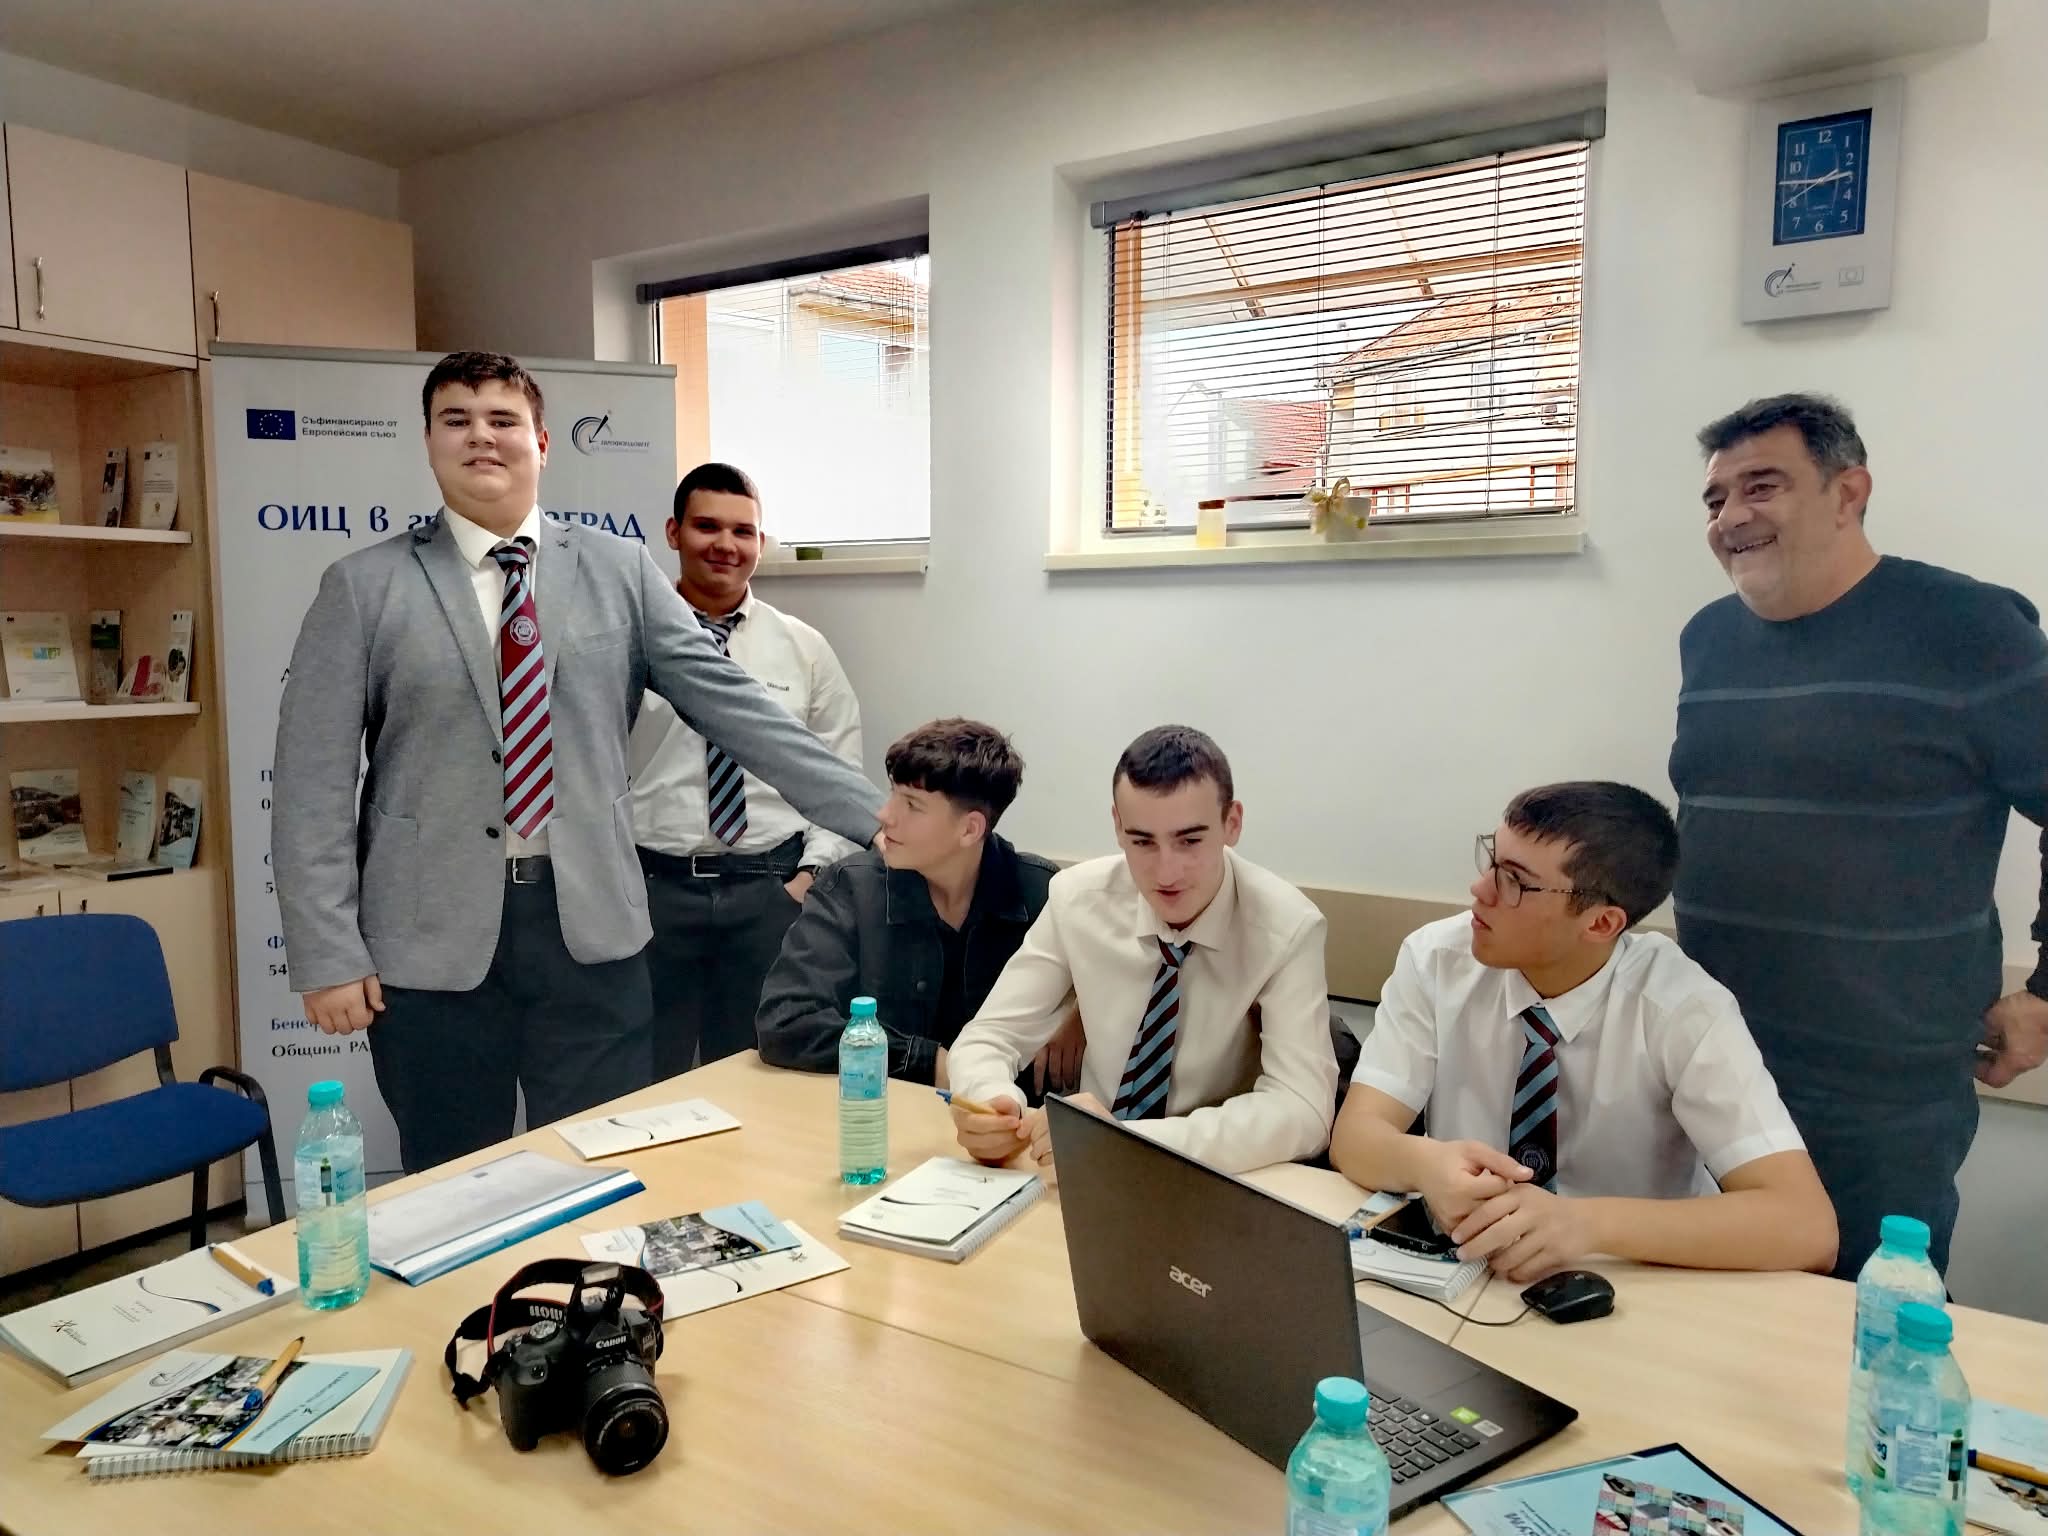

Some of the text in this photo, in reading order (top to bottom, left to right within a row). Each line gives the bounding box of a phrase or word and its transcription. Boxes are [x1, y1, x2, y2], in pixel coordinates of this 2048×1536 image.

[1818, 129, 1832, 144] 12
[1794, 143, 1806, 156] 11
[1845, 152, 1854, 166] 2
[1789, 160, 1802, 174] 10
[1842, 188, 1852, 201] 4
[1791, 216, 1801, 230] 7
[1840, 209, 1849, 224] 5
[1813, 219, 1825, 233] 6
[301, 416, 398, 428] Съфинансирано от
[302, 427, 397, 439] Европейския съюз
[257, 503, 351, 539] ОИЦ
[271, 1040, 370, 1059] Община РА
[1169, 1264, 1213, 1299] acer
[595, 1335, 627, 1349] Canon
